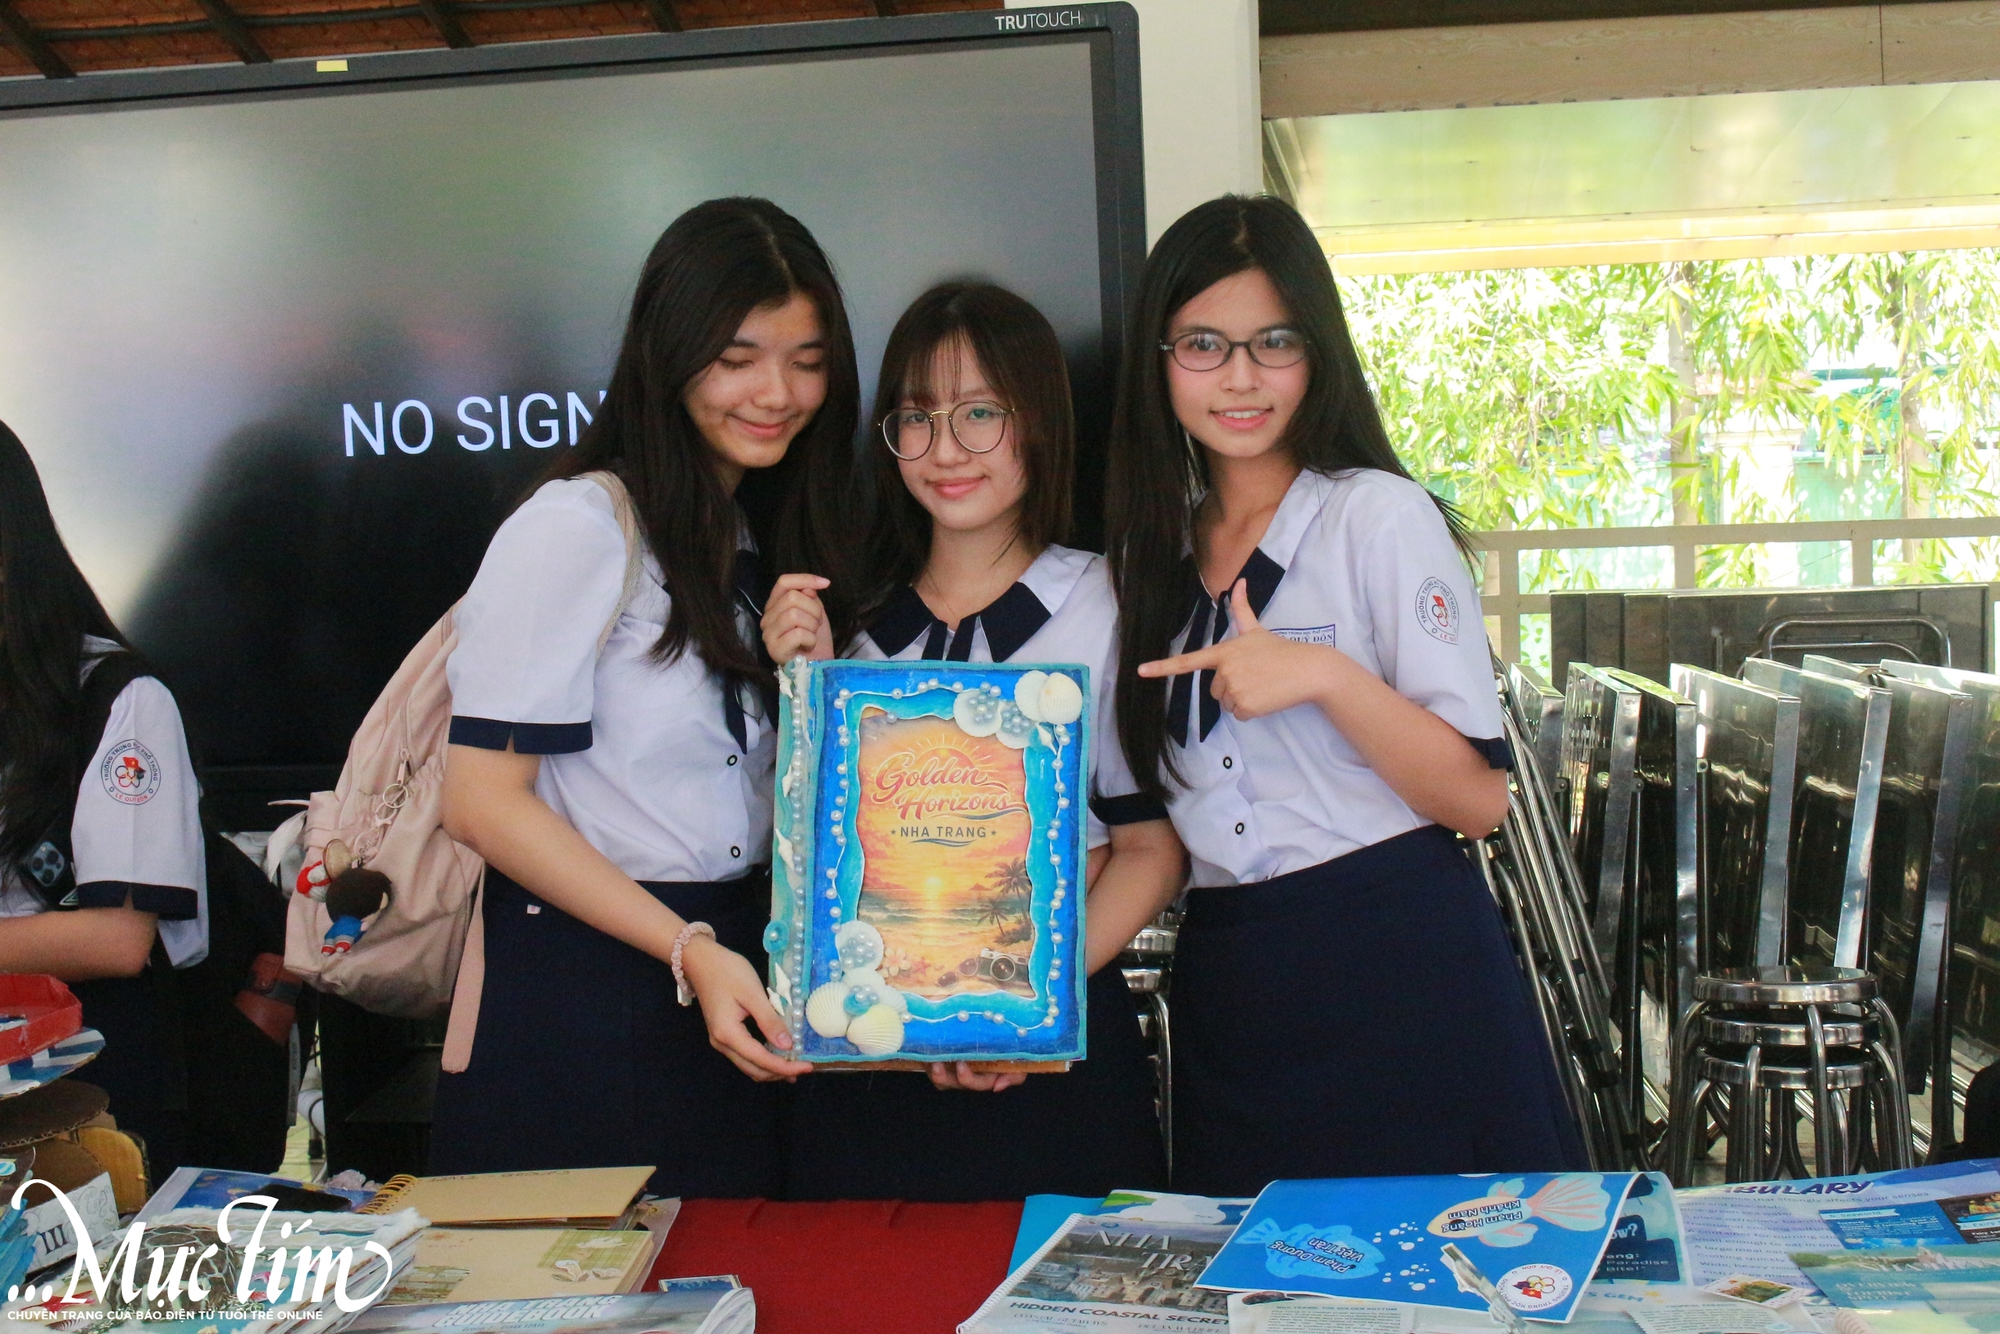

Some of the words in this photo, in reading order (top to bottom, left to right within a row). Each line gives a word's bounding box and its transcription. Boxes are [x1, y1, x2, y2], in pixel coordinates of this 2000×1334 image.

[995, 10, 1081, 31] TRUTOUCH
[342, 399, 435, 457] NO
[871, 751, 990, 804] Golden
[894, 787, 1010, 820] Horizons
[900, 826, 930, 838] NHA
[936, 826, 987, 838] TRANG
[1448, 1208, 1478, 1219] Nam
[1480, 1200, 1521, 1214] Khánh
[1485, 1211, 1523, 1224] Phạm
[1313, 1255, 1351, 1273] Phạm
[448, 1300, 513, 1316] NHA
[521, 1294, 623, 1311] TRANG
[1008, 1301, 1077, 1314] HIDDEN
[1079, 1308, 1159, 1320] COASTAL
[432, 1305, 609, 1327] GUIDEBOOK
